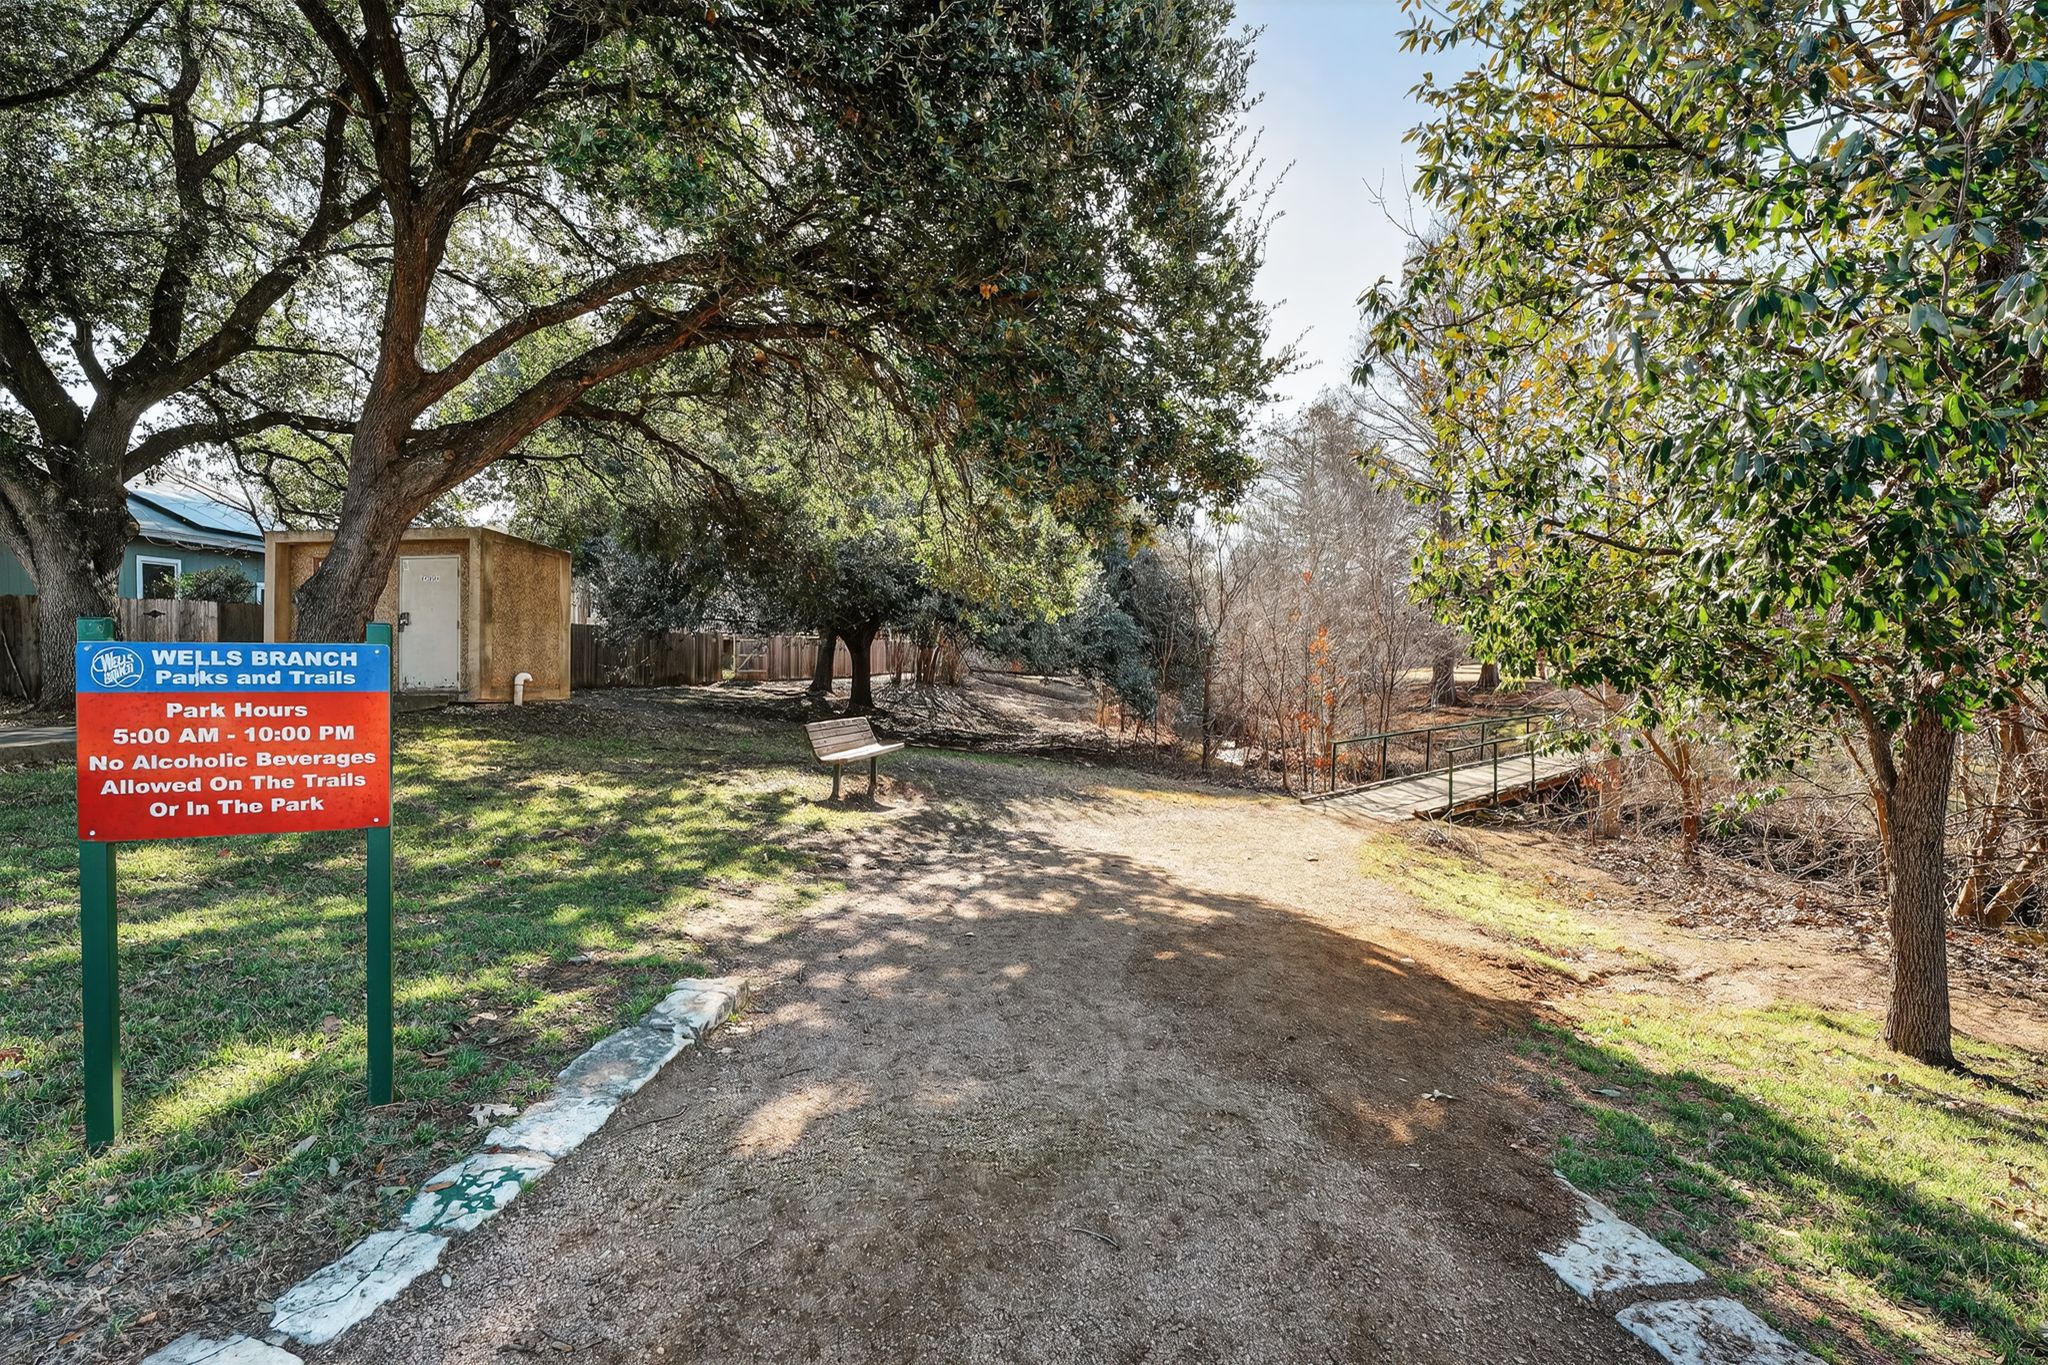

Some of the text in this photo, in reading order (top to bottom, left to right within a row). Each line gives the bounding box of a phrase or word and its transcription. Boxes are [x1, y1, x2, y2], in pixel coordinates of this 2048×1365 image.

[152, 650, 357, 666] WELLS BRANCH
[155, 670, 356, 685] Parks and Trails
[167, 703, 307, 718] Park Hours
[113, 728, 170, 744] 5:00
[178, 728, 219, 743] AM
[244, 726, 311, 742] 10:00
[319, 726, 354, 741] PM
[90, 751, 376, 771] No Alcoholic Beverages
[101, 773, 366, 795] Allowed On The Trails
[149, 797, 324, 817] Or In The Park
